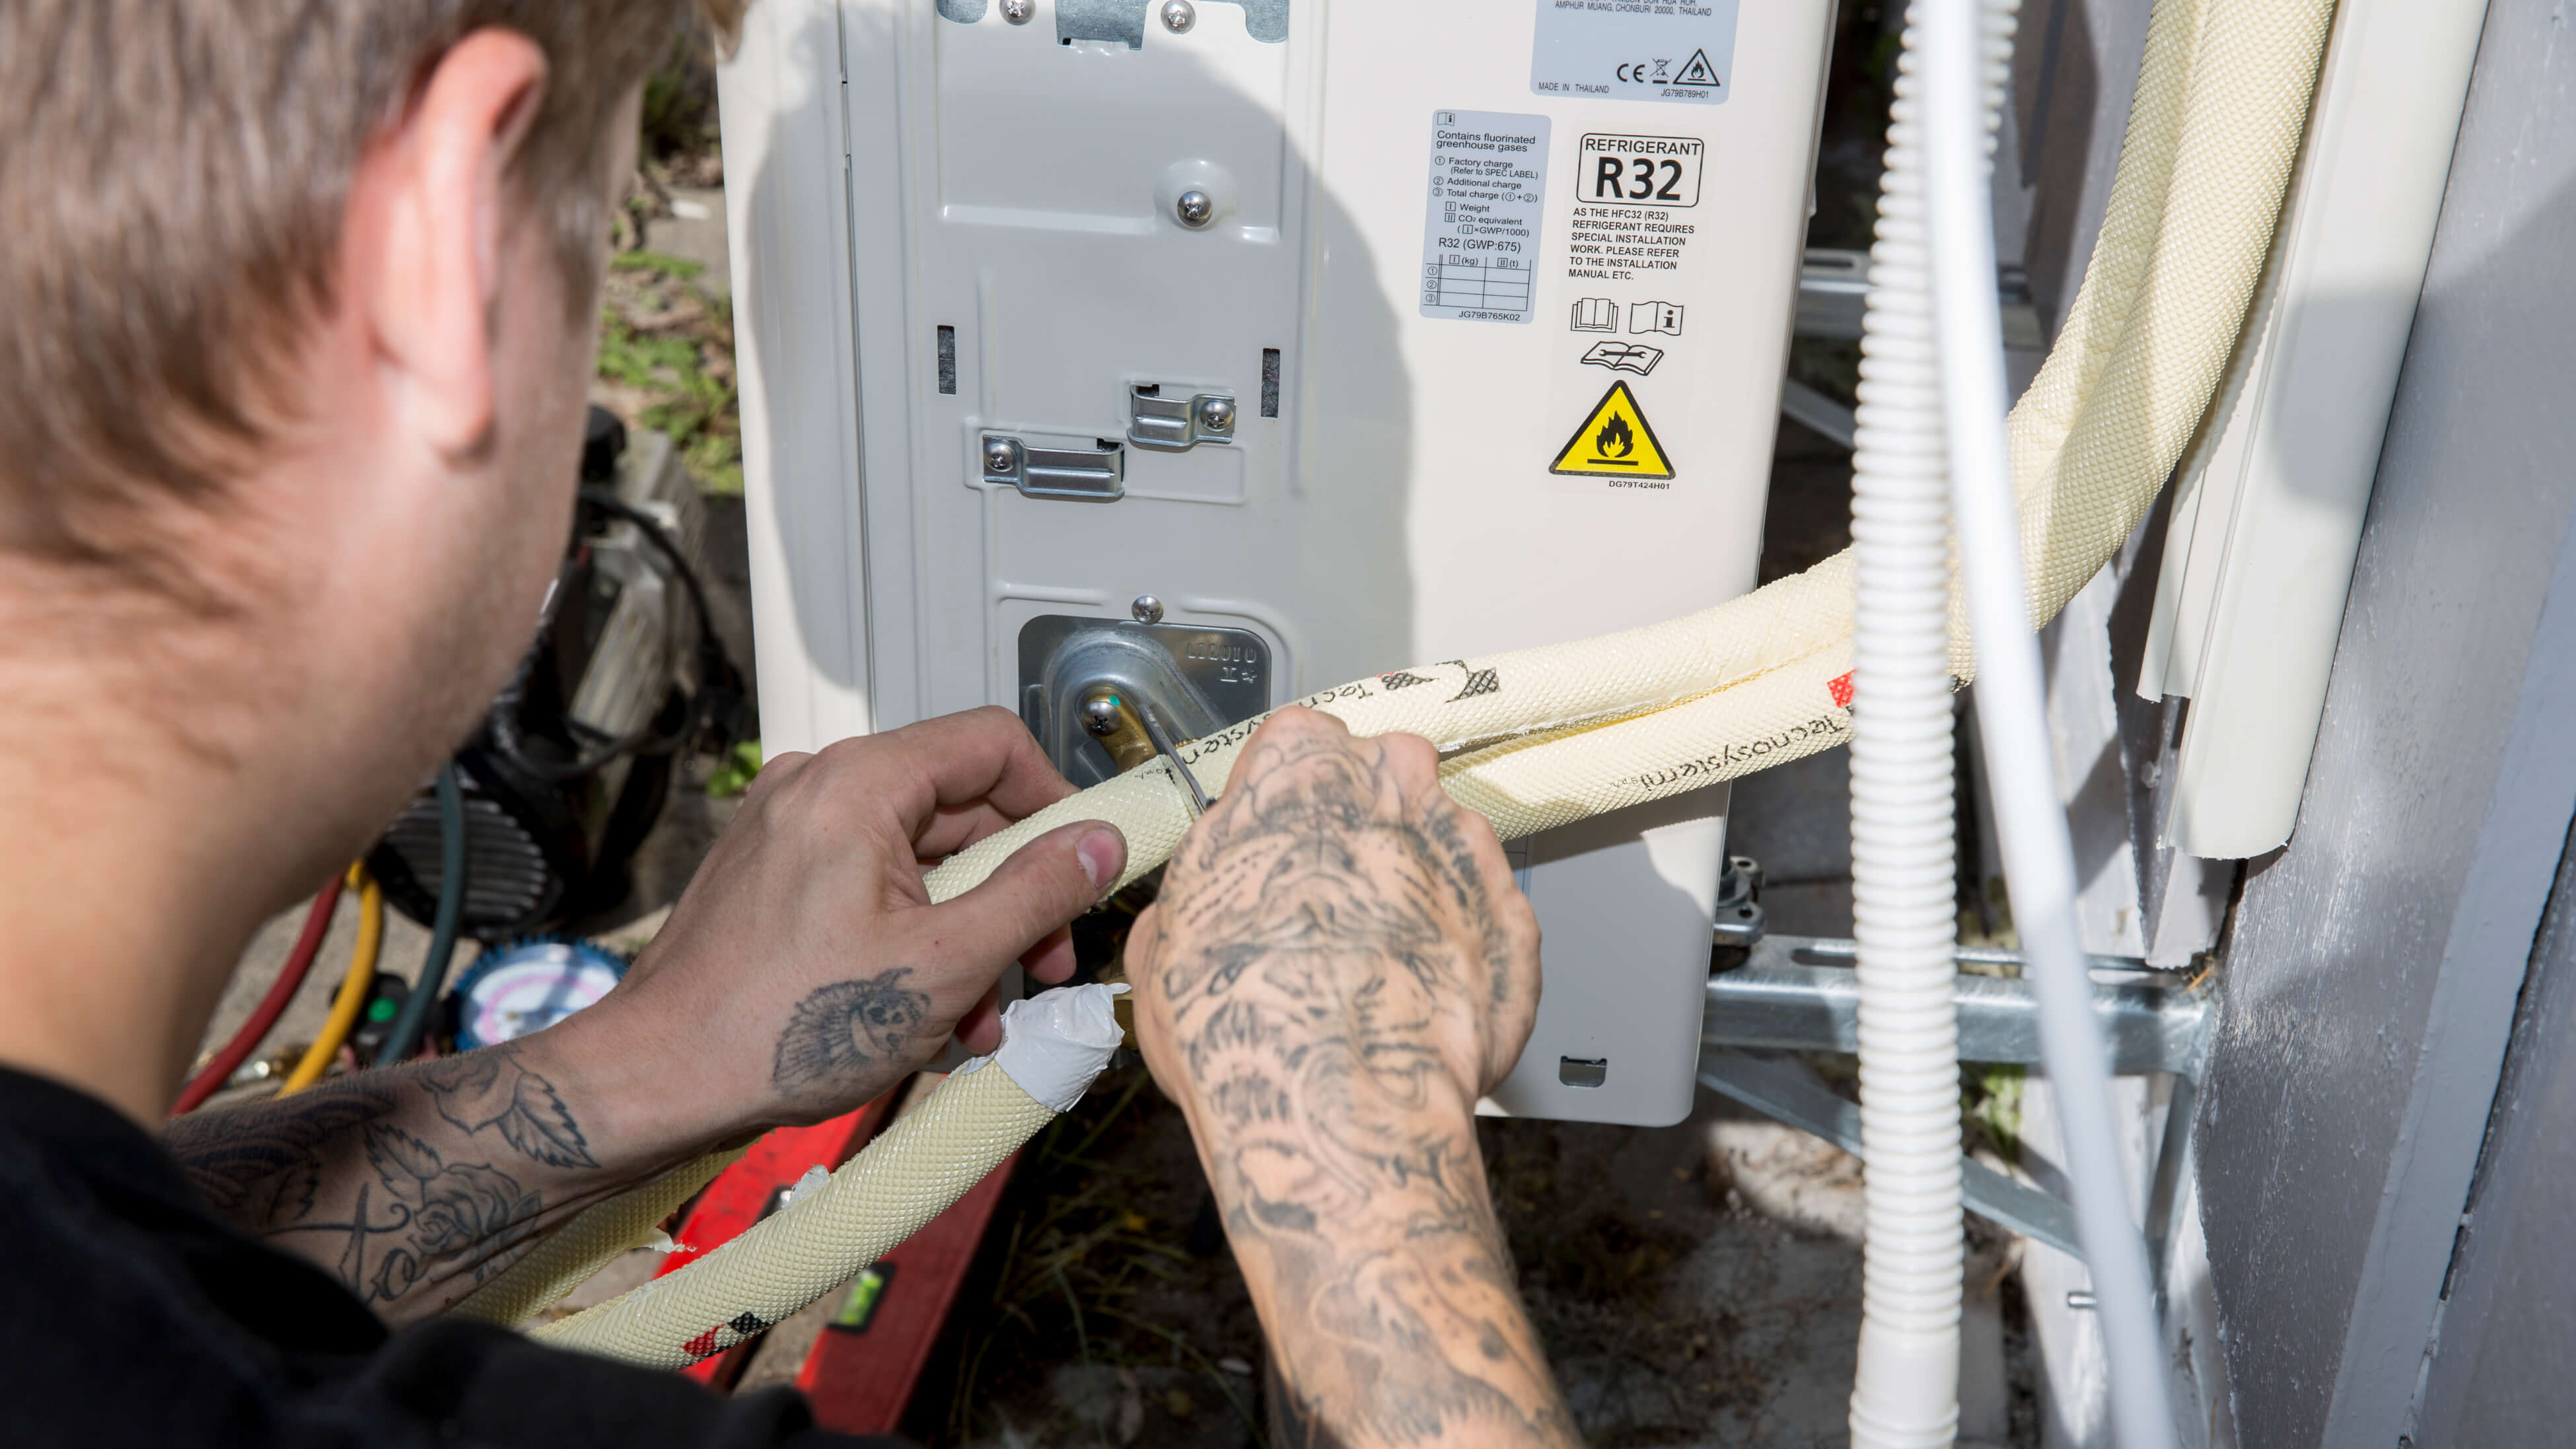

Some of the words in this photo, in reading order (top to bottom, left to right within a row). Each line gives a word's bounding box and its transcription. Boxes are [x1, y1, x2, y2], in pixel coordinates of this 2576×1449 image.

[1555, 1, 1584, 9] AMPHUR
[1616, 3, 1651, 13] CHONBURI
[1679, 7, 1712, 16] THAILAND
[1538, 82, 1558, 90] MADE
[1575, 84, 1609, 93] THAILAND
[1661, 88, 1709, 98] JG79B789H01
[1437, 130, 1480, 141] Contains
[1484, 133, 1536, 144] fluorinated
[1437, 140, 1495, 150] greenhouse
[1498, 143, 1527, 153] gases
[1585, 138, 1701, 155] REFRIGERANT
[1449, 157, 1481, 167] Factory
[1484, 160, 1513, 168] charge
[1450, 166, 1474, 175] (Refer
[1509, 170, 1538, 180] LABEL)
[1596, 157, 1682, 201] R32
[1447, 178, 1489, 187] Additional
[1492, 180, 1522, 190] charge
[1469, 191, 1499, 200] charge
[1460, 203, 1490, 213] Weight
[1573, 207, 1587, 216] AS
[1590, 208, 1608, 217] THE
[1612, 209, 1642, 219] HFC32
[1645, 211, 1669, 222] (R32)
[1478, 217, 1522, 226] equivalent
[1573, 220, 1642, 231] REFRIGERANT
[1645, 223, 1695, 234] REQUIRES
[1571, 232, 1612, 242] SPECIAL
[1616, 234, 1686, 246] INSTALLATION
[1439, 238, 1460, 248] R32
[1463, 238, 1521, 254] (GWP:675)
[1570, 244, 1603, 254] WORK.
[1606, 246, 1644, 256] PLEASE
[1647, 248, 1679, 258] REFER
[1462, 257, 1478, 266] (kg)
[1510, 260, 1519, 268] (t)
[1585, 258, 1604, 266] THE
[1607, 259, 1677, 269] INSTALLATION
[1569, 269, 1610, 279] MANUAL
[1612, 271, 1633, 280] ETC.
[1458, 310, 1521, 321] JG79B765K02
[1609, 480, 1670, 489] DG79T424H01
[1639, 715, 1845, 791] Tecnosystemi
